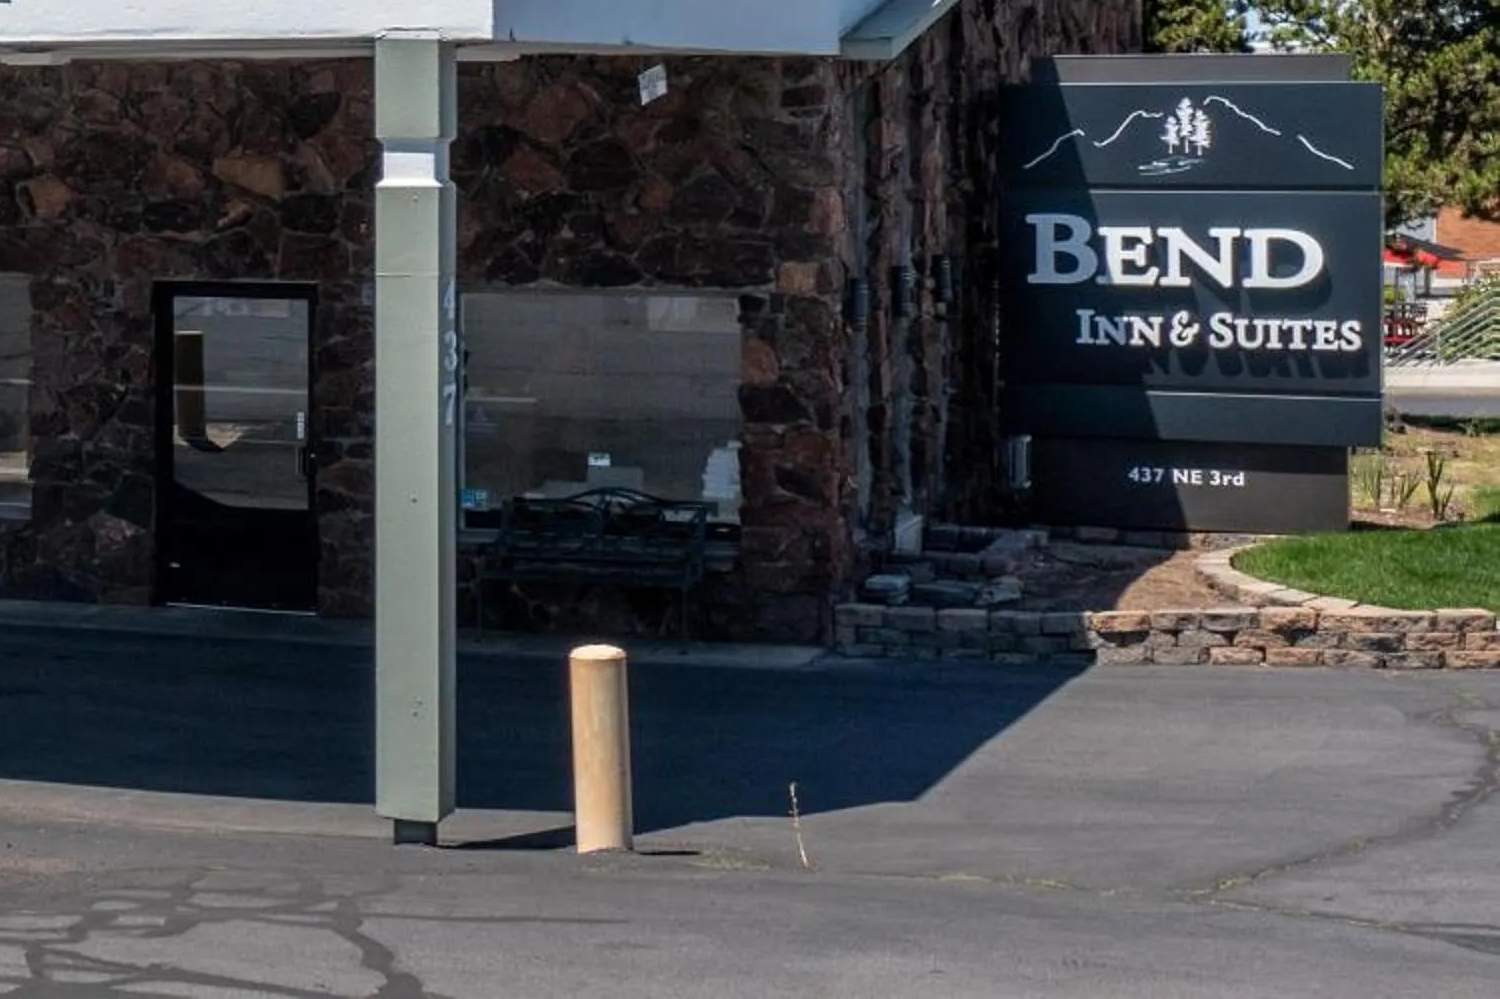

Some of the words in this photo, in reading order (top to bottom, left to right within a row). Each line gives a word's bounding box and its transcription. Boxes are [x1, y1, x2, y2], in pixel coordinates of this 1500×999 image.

[1025, 213, 1324, 289] BEND
[1076, 308, 1164, 347] INN
[1169, 310, 1199, 348] &
[1209, 312, 1362, 351] SUITES
[1128, 466, 1164, 483] 437
[1172, 468, 1203, 485] NE
[1209, 470, 1245, 487] 3rd
